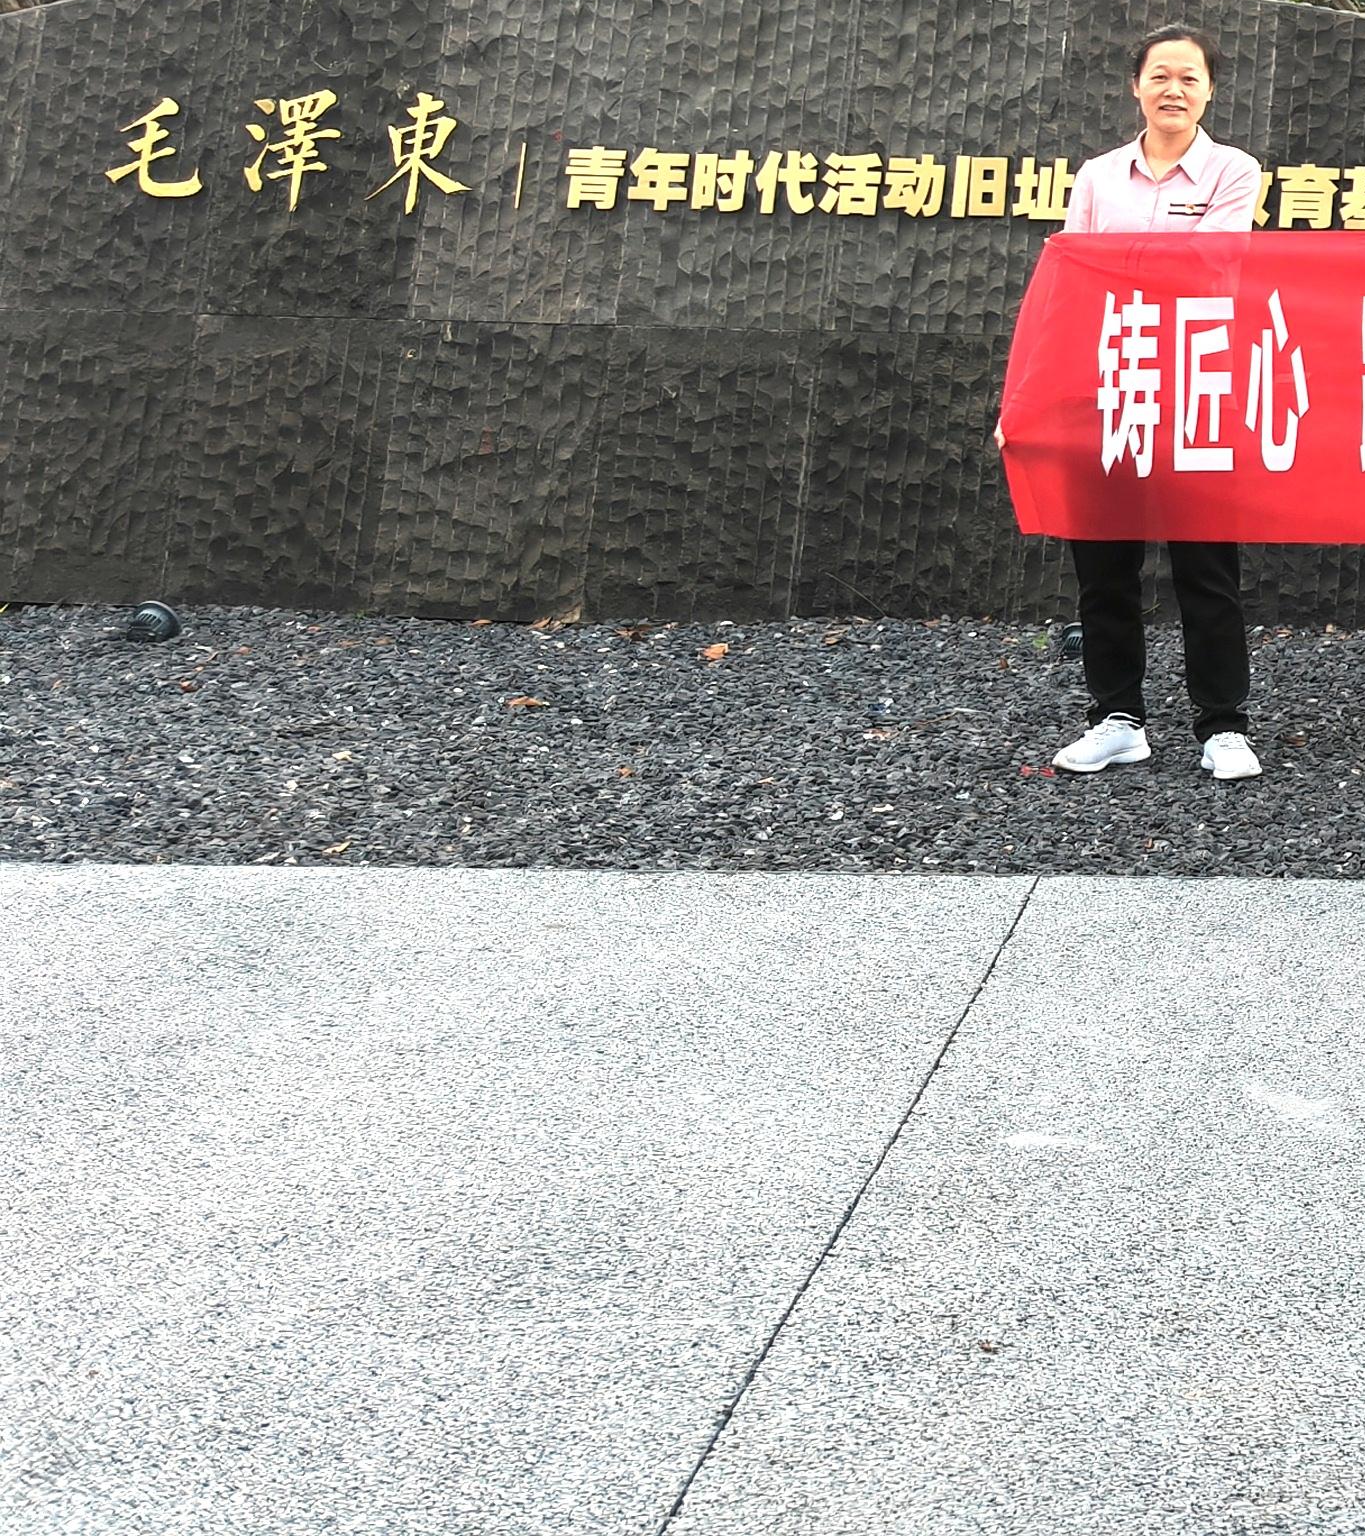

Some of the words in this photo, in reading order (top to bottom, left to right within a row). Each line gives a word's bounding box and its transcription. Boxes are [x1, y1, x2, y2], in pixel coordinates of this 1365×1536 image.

[106, 89, 472, 216] 毛澤東
[1098, 288, 1310, 478] 铸匠心
